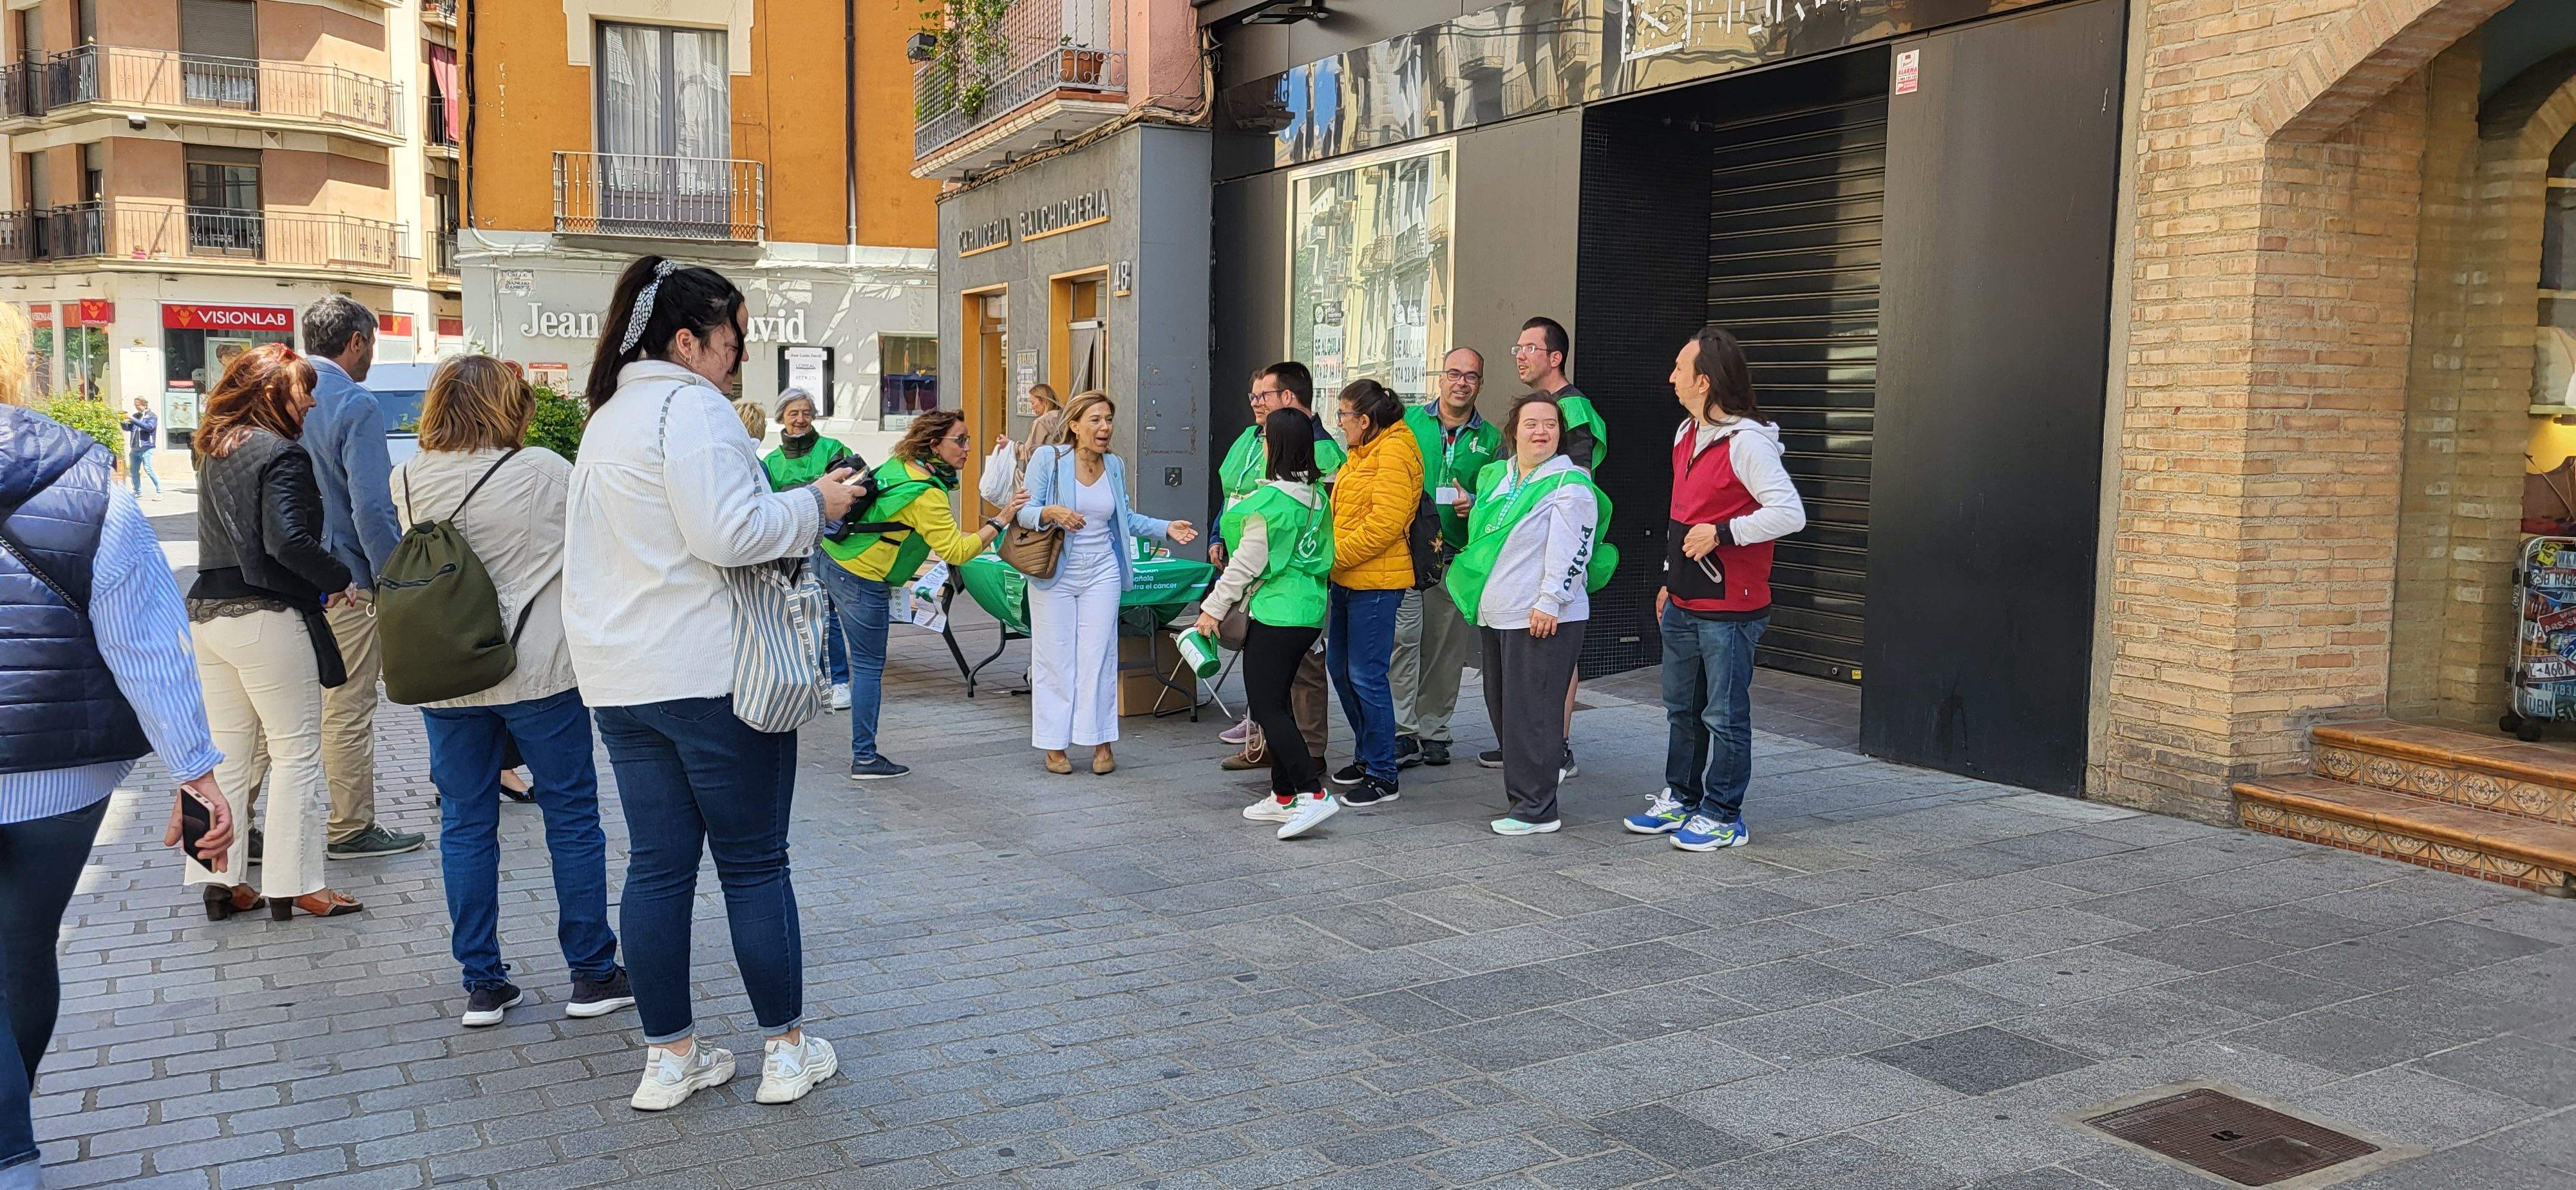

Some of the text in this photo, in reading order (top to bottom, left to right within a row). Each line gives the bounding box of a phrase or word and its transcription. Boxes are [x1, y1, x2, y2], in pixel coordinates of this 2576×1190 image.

[958, 189, 1107, 254] CARNICERIA SALCHICHERIA
[1113, 260, 1130, 292] 48
[197, 310, 287, 326] VISIONLAB
[520, 302, 808, 344] Jean avid
[1314, 339, 1321, 356] SE
[1395, 339, 1401, 358] SE
[1395, 367, 1403, 383] 974
[1404, 366, 1410, 383] 23
